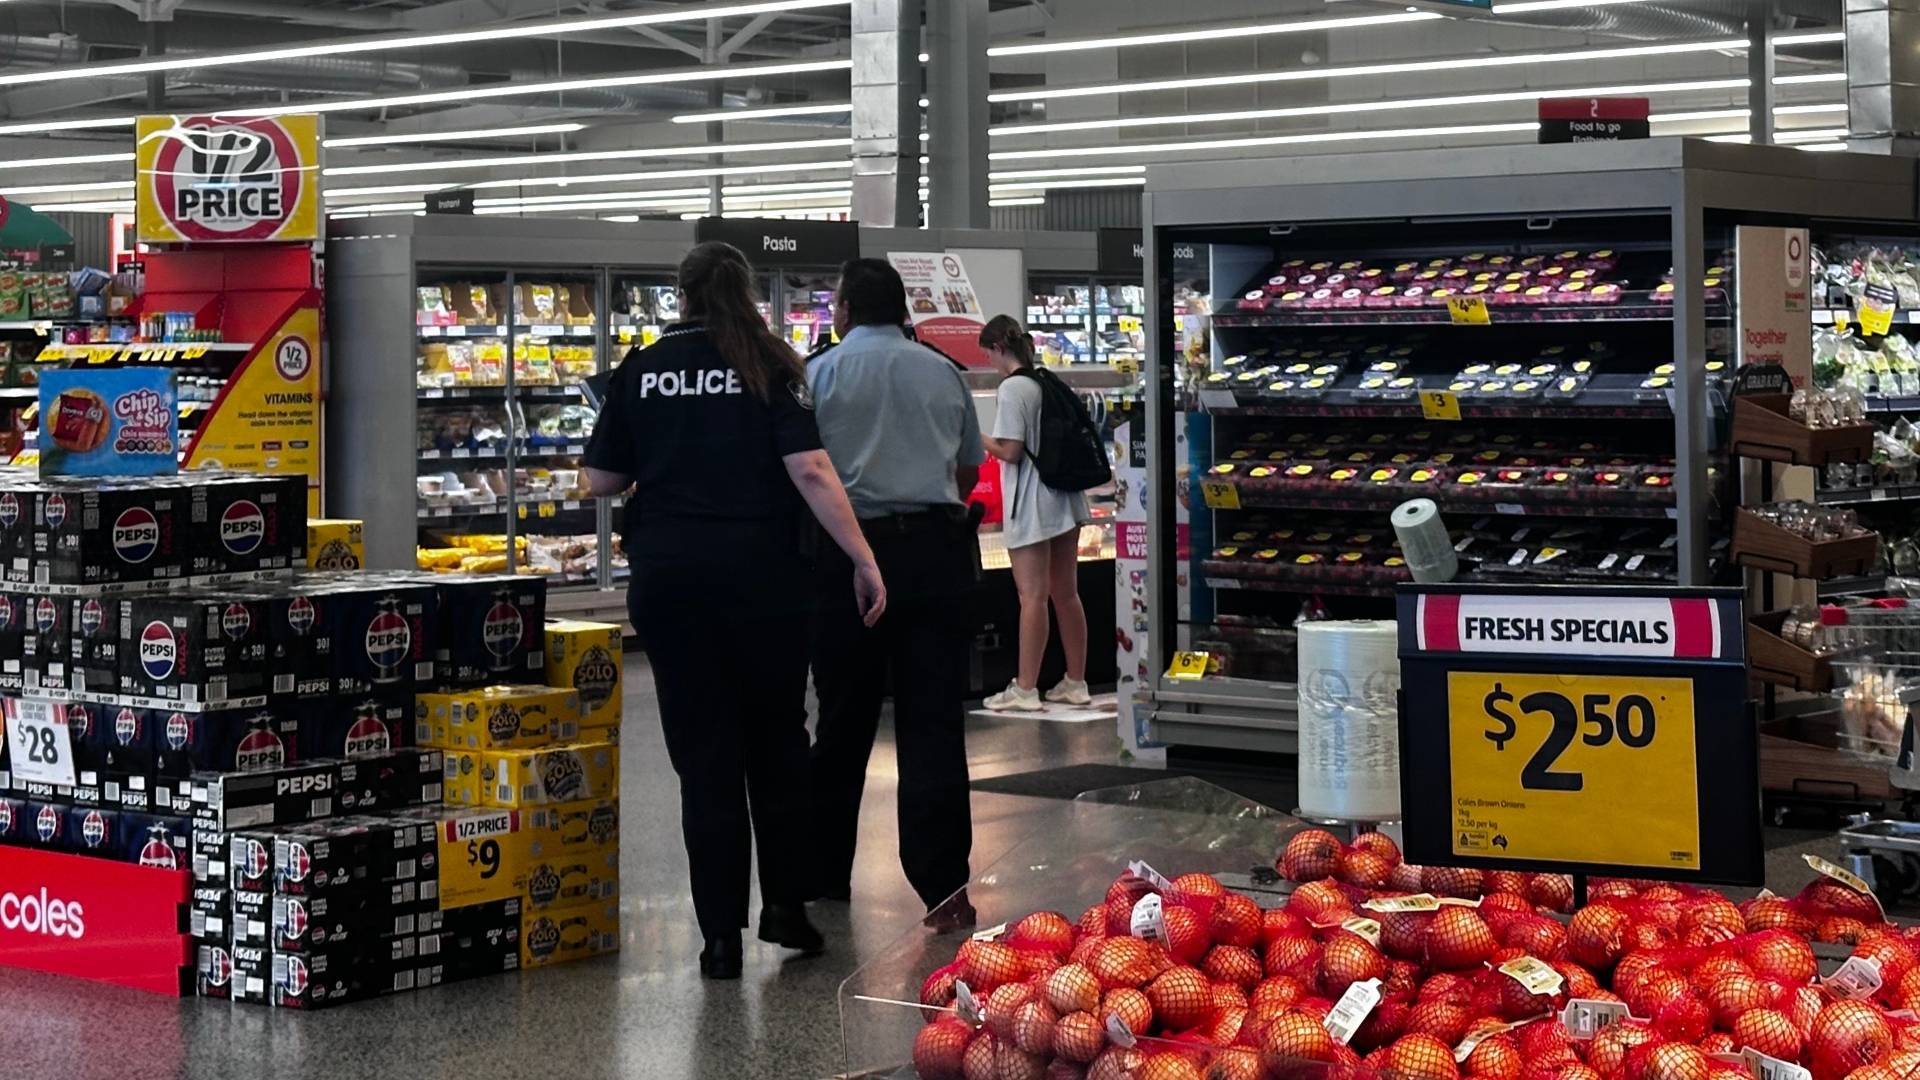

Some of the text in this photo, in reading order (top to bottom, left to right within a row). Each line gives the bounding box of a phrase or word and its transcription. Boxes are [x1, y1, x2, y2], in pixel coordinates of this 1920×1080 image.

[1570, 122, 1621, 133] Food to go
[178, 188, 281, 218] PRICE
[763, 236, 797, 252] Pasta
[1745, 329, 1787, 348] Together
[285, 346, 302, 361] 1/2
[640, 368, 742, 398] POLICE
[118, 390, 157, 415] Chip
[264, 393, 313, 405] VITAMINS
[144, 409, 169, 427] Sip
[122, 428, 137, 438] this
[1131, 441, 1146, 450] SIM
[222, 520, 262, 534] PEPSI
[1126, 525, 1146, 534] AUST
[115, 528, 156, 542] PEPSI
[1127, 543, 1147, 556] WR
[7, 571, 29, 582] PEPSI
[224, 615, 249, 627] PEPSI
[485, 622, 520, 636] PEPSI
[1465, 616, 1669, 645] FRESH SPECIALS
[368, 632, 408, 647] PEPSI
[143, 643, 174, 657] PEPSI
[577, 664, 613, 682] SOLO
[42, 676, 64, 688] PEPSI
[298, 681, 330, 694] PEPSI
[490, 713, 518, 731] SOLO
[17, 720, 59, 765] $28
[347, 738, 387, 754] PEPSI
[239, 752, 282, 767] PEPSI
[546, 755, 584, 786] SOLO
[28, 783, 53, 796] PEPSI
[277, 773, 333, 796] PEPSI
[74, 788, 99, 801] PEPSI
[122, 793, 148, 806] PEPSI
[172, 799, 191, 811] PEP
[1458, 799, 1526, 809] Coles Brown Onions
[193, 818, 217, 830] PEPSI
[458, 816, 509, 838] 1/2 PRICE
[1476, 821, 1488, 831] per
[1488, 821, 1498, 831] kg
[197, 832, 224, 846] PEPSI
[467, 838, 501, 880] $9
[530, 876, 558, 892] SOLO
[194, 888, 221, 901] PEPSI
[236, 892, 264, 905] PEPSI
[2, 886, 85, 940] coles
[530, 930, 557, 945] SOLO
[235, 949, 262, 961] PEPSI
